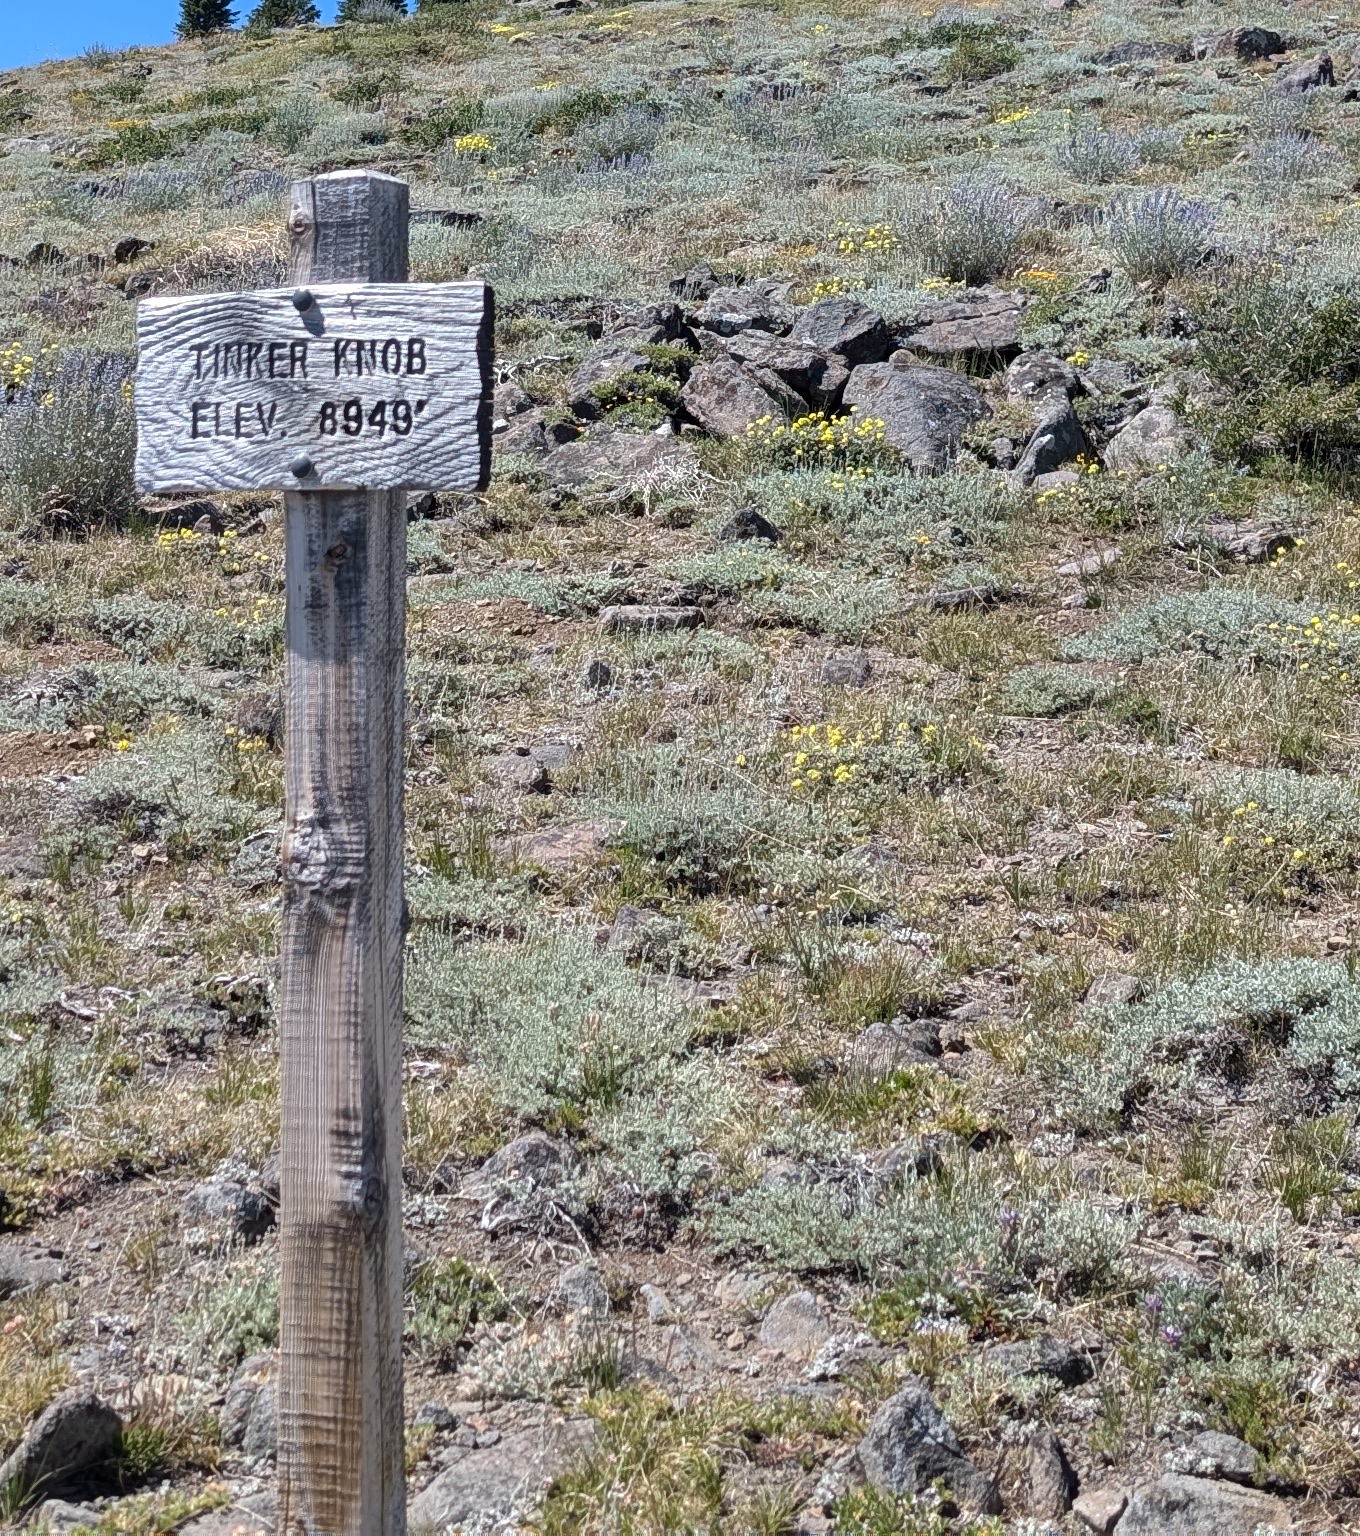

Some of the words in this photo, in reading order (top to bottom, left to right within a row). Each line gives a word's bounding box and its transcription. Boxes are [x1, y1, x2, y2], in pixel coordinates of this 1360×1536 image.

[189, 341, 308, 379] TINKER
[333, 338, 427, 376] KNOB
[190, 401, 288, 439] ELEV.
